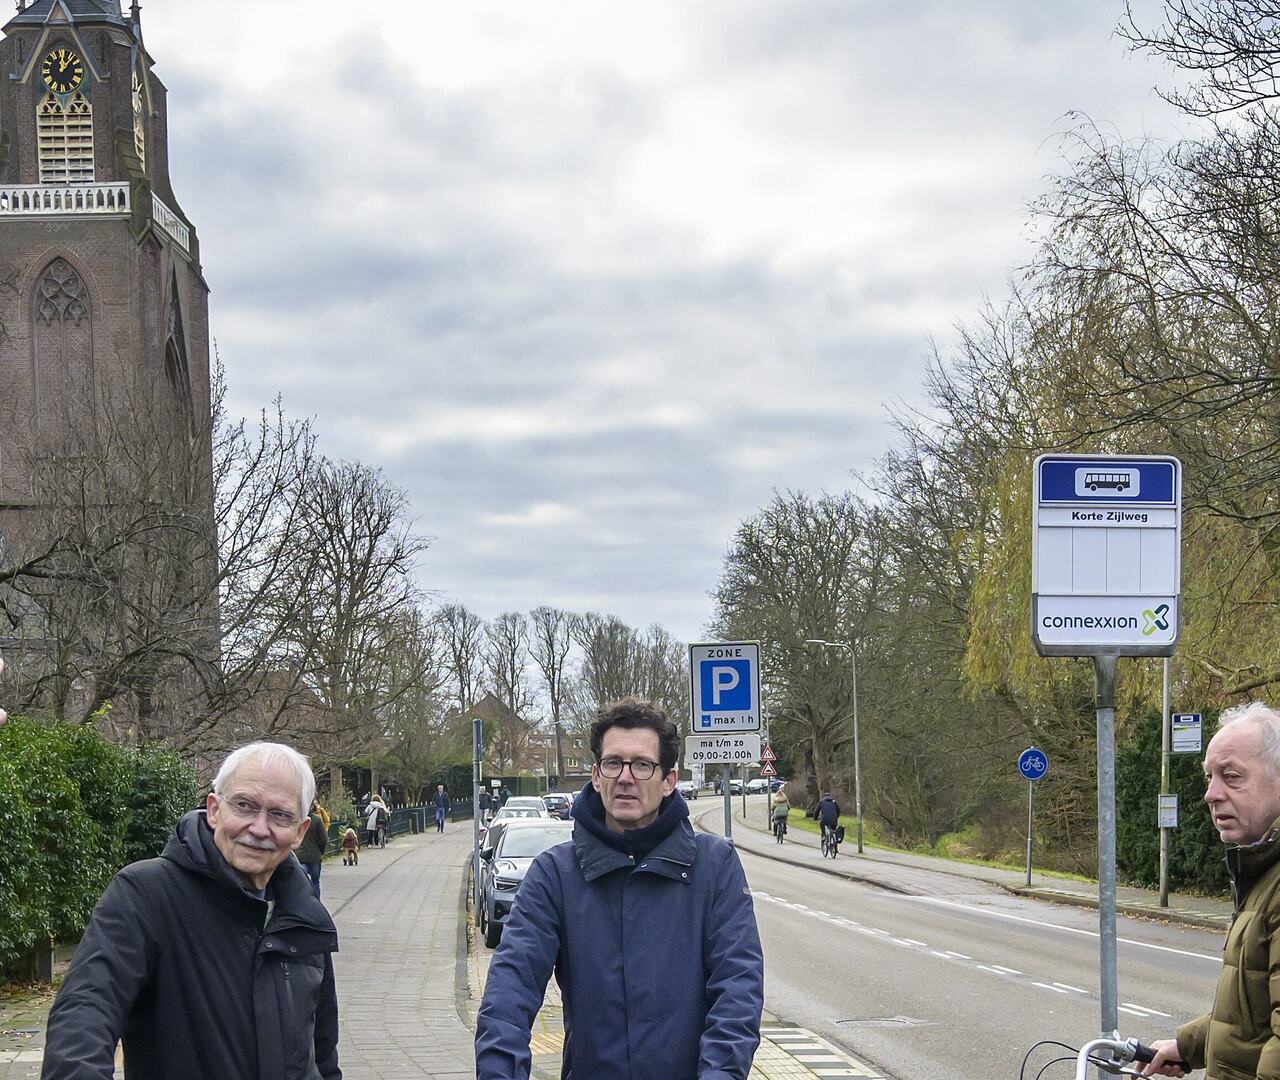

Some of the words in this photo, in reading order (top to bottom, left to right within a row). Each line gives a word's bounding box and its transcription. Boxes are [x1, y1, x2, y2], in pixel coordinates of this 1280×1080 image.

[1071, 511, 1104, 521] Korte
[1106, 511, 1149, 523] Zijlweg
[1042, 615, 1138, 629] connexxion
[707, 648, 743, 659] ZONE
[711, 665, 740, 705] P
[714, 716, 736, 725] max
[747, 714, 754, 724] h
[700, 740, 713, 748] ma
[716, 738, 731, 748] t/m
[734, 739, 744, 748] zo
[692, 750, 752, 760] 09.00-21.00h
